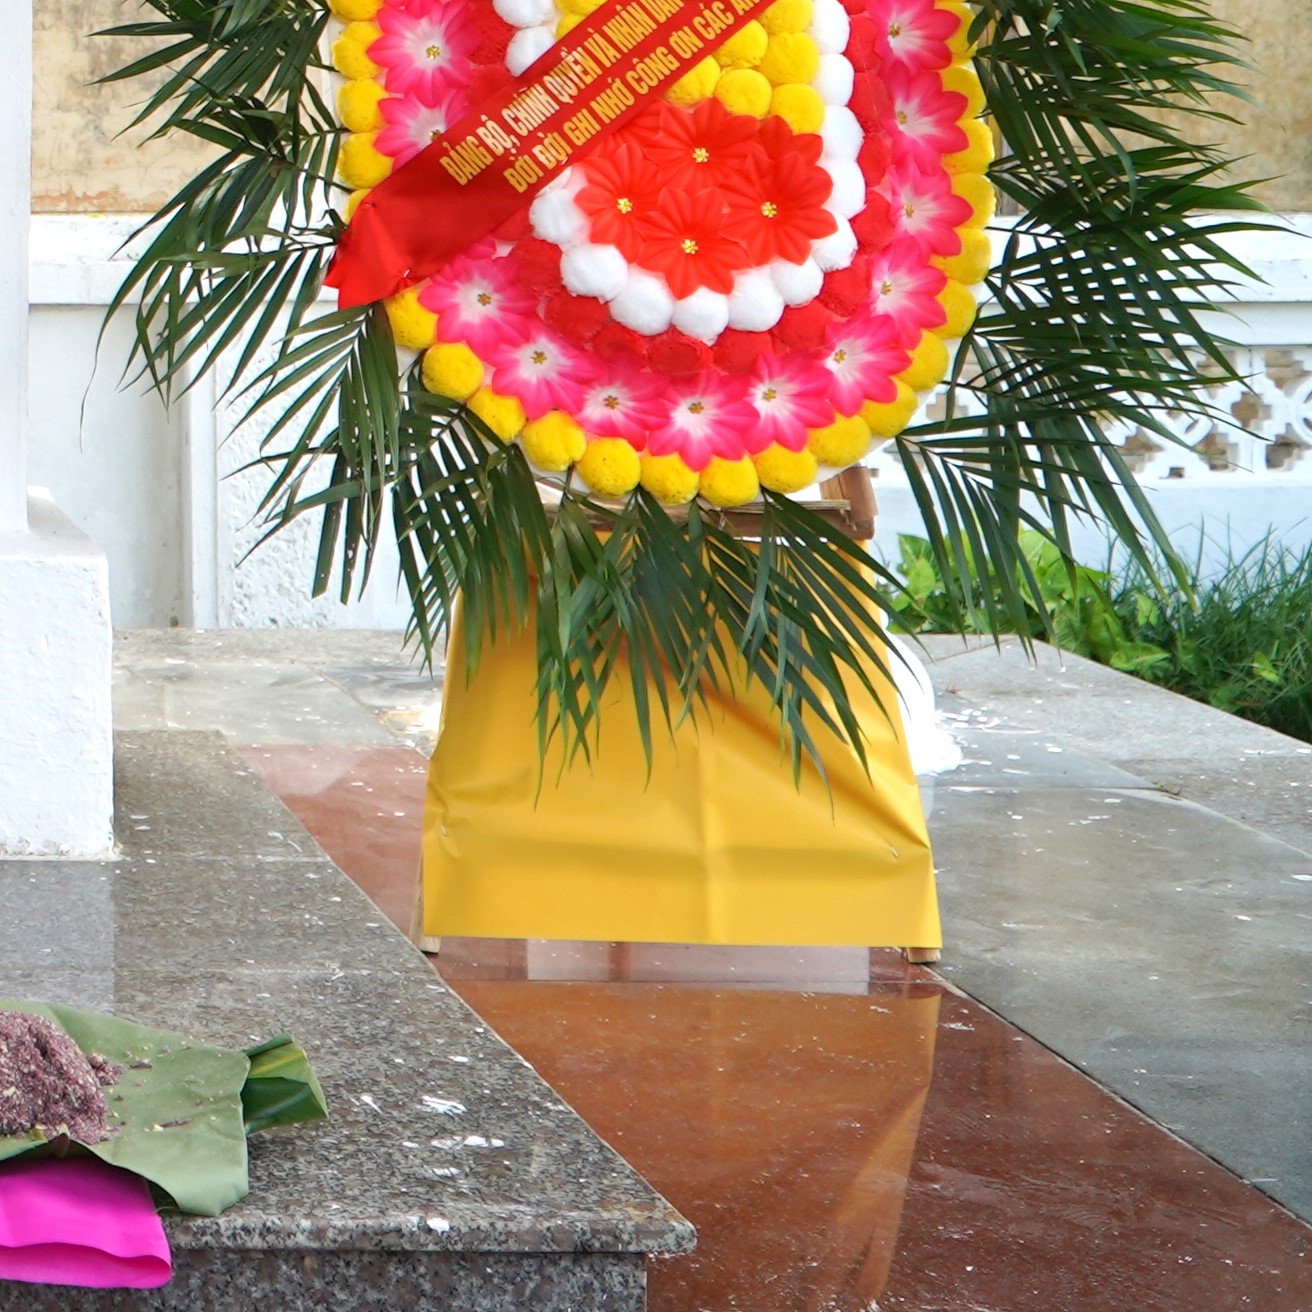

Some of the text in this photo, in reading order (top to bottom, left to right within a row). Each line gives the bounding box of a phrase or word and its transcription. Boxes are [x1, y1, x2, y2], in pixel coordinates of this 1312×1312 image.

[439, 141, 494, 185] ĐẢNG
[476, 115, 520, 156] BỘ,
[543, 46, 602, 104] QUYỀN
[583, 28, 621, 68] VÀ
[602, 2, 658, 53] NHÂN
[503, 154, 544, 193] ĐỜI
[563, 109, 602, 146] GHI
[590, 77, 635, 124] NHỚ
[625, 58, 680, 95] CÔNG
[669, 26, 704, 59] ƠN
[693, 1, 735, 40] CÁC
